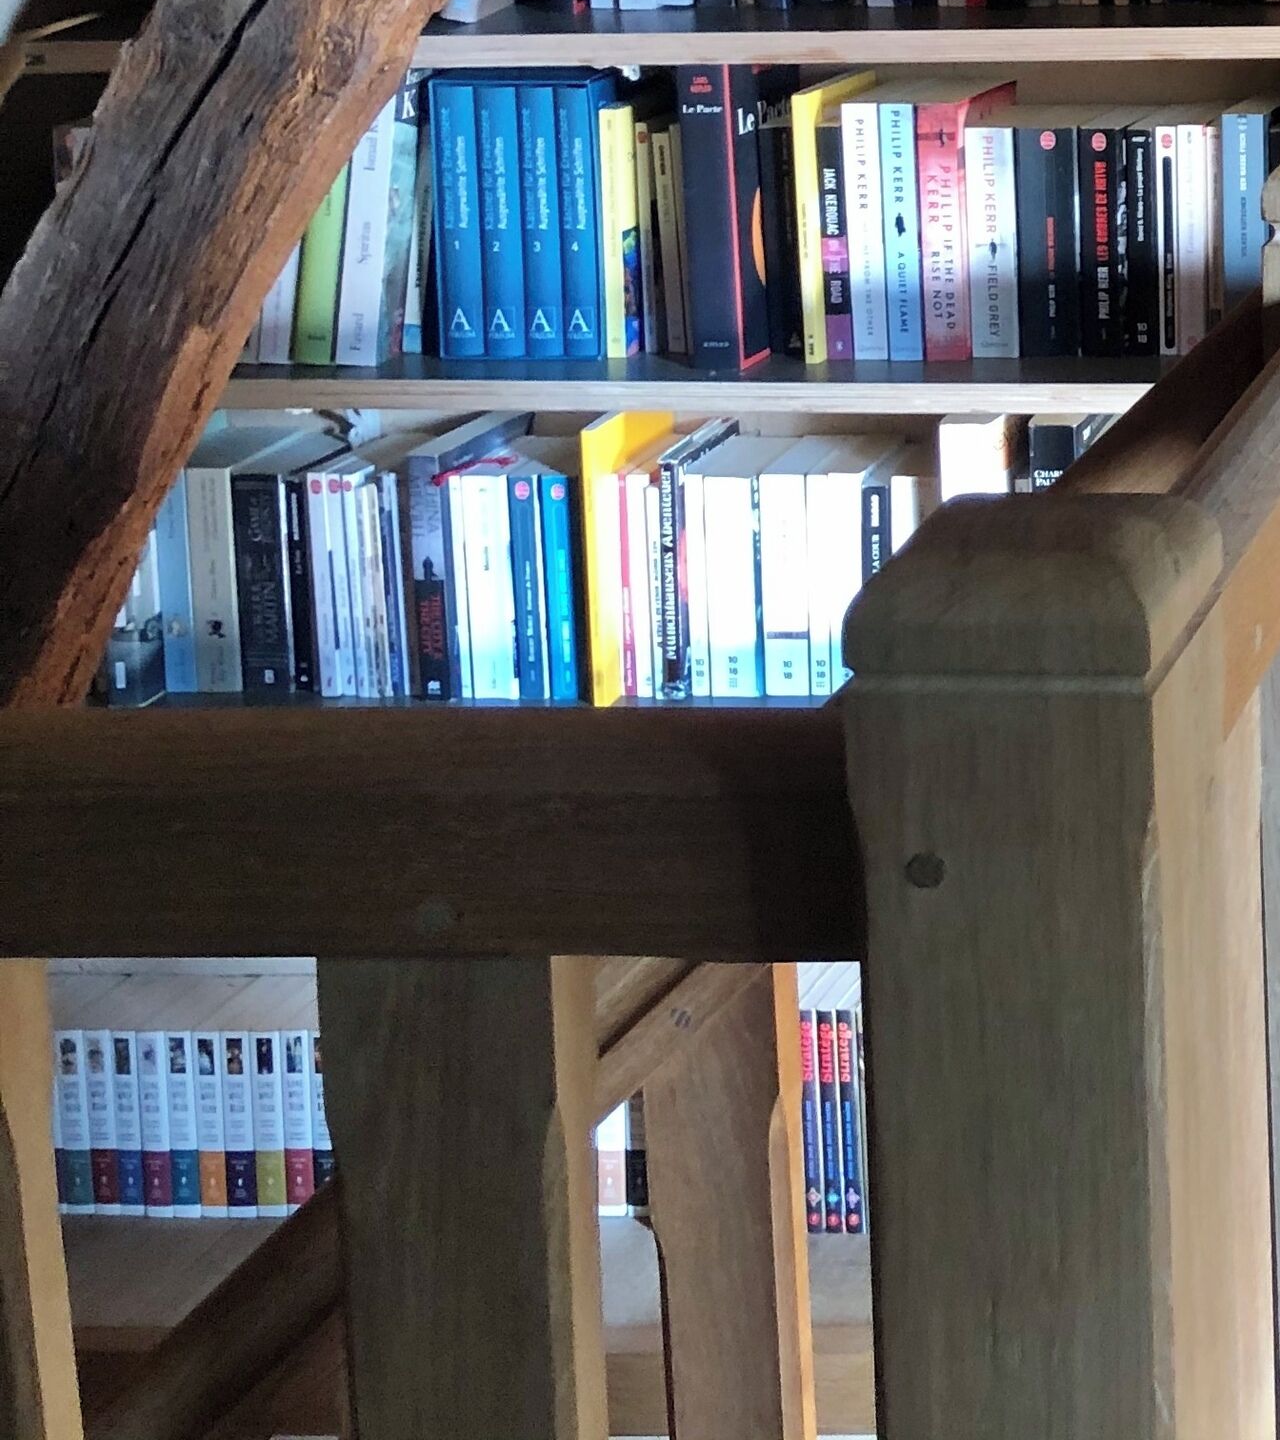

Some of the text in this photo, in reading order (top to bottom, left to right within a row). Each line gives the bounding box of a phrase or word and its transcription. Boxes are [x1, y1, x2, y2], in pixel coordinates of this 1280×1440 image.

[682, 104, 724, 114] Le Pacte
[737, 108, 755, 136] Le
[1239, 133, 1247, 152] FISCH
[855, 118, 868, 211] PHILIP KERR
[891, 110, 904, 204] PHILIP KERR
[455, 136, 470, 230] Ausgewählte Schriften
[494, 136, 510, 230] Ausgewählte Schriften
[534, 136, 549, 230] Ausgewählte Schriften
[572, 136, 587, 230] Ausgewählte Schriften
[982, 135, 997, 234] PHILIP KERR
[1239, 177, 1247, 192] DER
[823, 168, 840, 236] JACK KEROUAC
[927, 174, 938, 223] KERR
[939, 165, 953, 232] PHILIP
[349, 137, 378, 352] Fayard Spiritus Ismail
[455, 241, 461, 250] 1
[492, 241, 501, 252] 2
[533, 241, 542, 252] 3
[571, 241, 580, 252] 4
[930, 251, 943, 320] RISE NOT
[943, 239, 956, 330] IF THE DEAD
[1097, 266, 1109, 289] KERR
[830, 280, 843, 304] ROAD
[897, 251, 909, 334] A QUIET FLAME
[987, 264, 1001, 337] FIELD GREY
[1098, 292, 1110, 320] PHILIP
[450, 308, 470, 332] A
[490, 308, 510, 332] A
[531, 308, 551, 332] A
[569, 308, 589, 332] A
[866, 308, 874, 337] OTHER
[659, 467, 674, 548] Abenteuer
[728, 656, 738, 664] 10
[783, 660, 792, 668] 10
